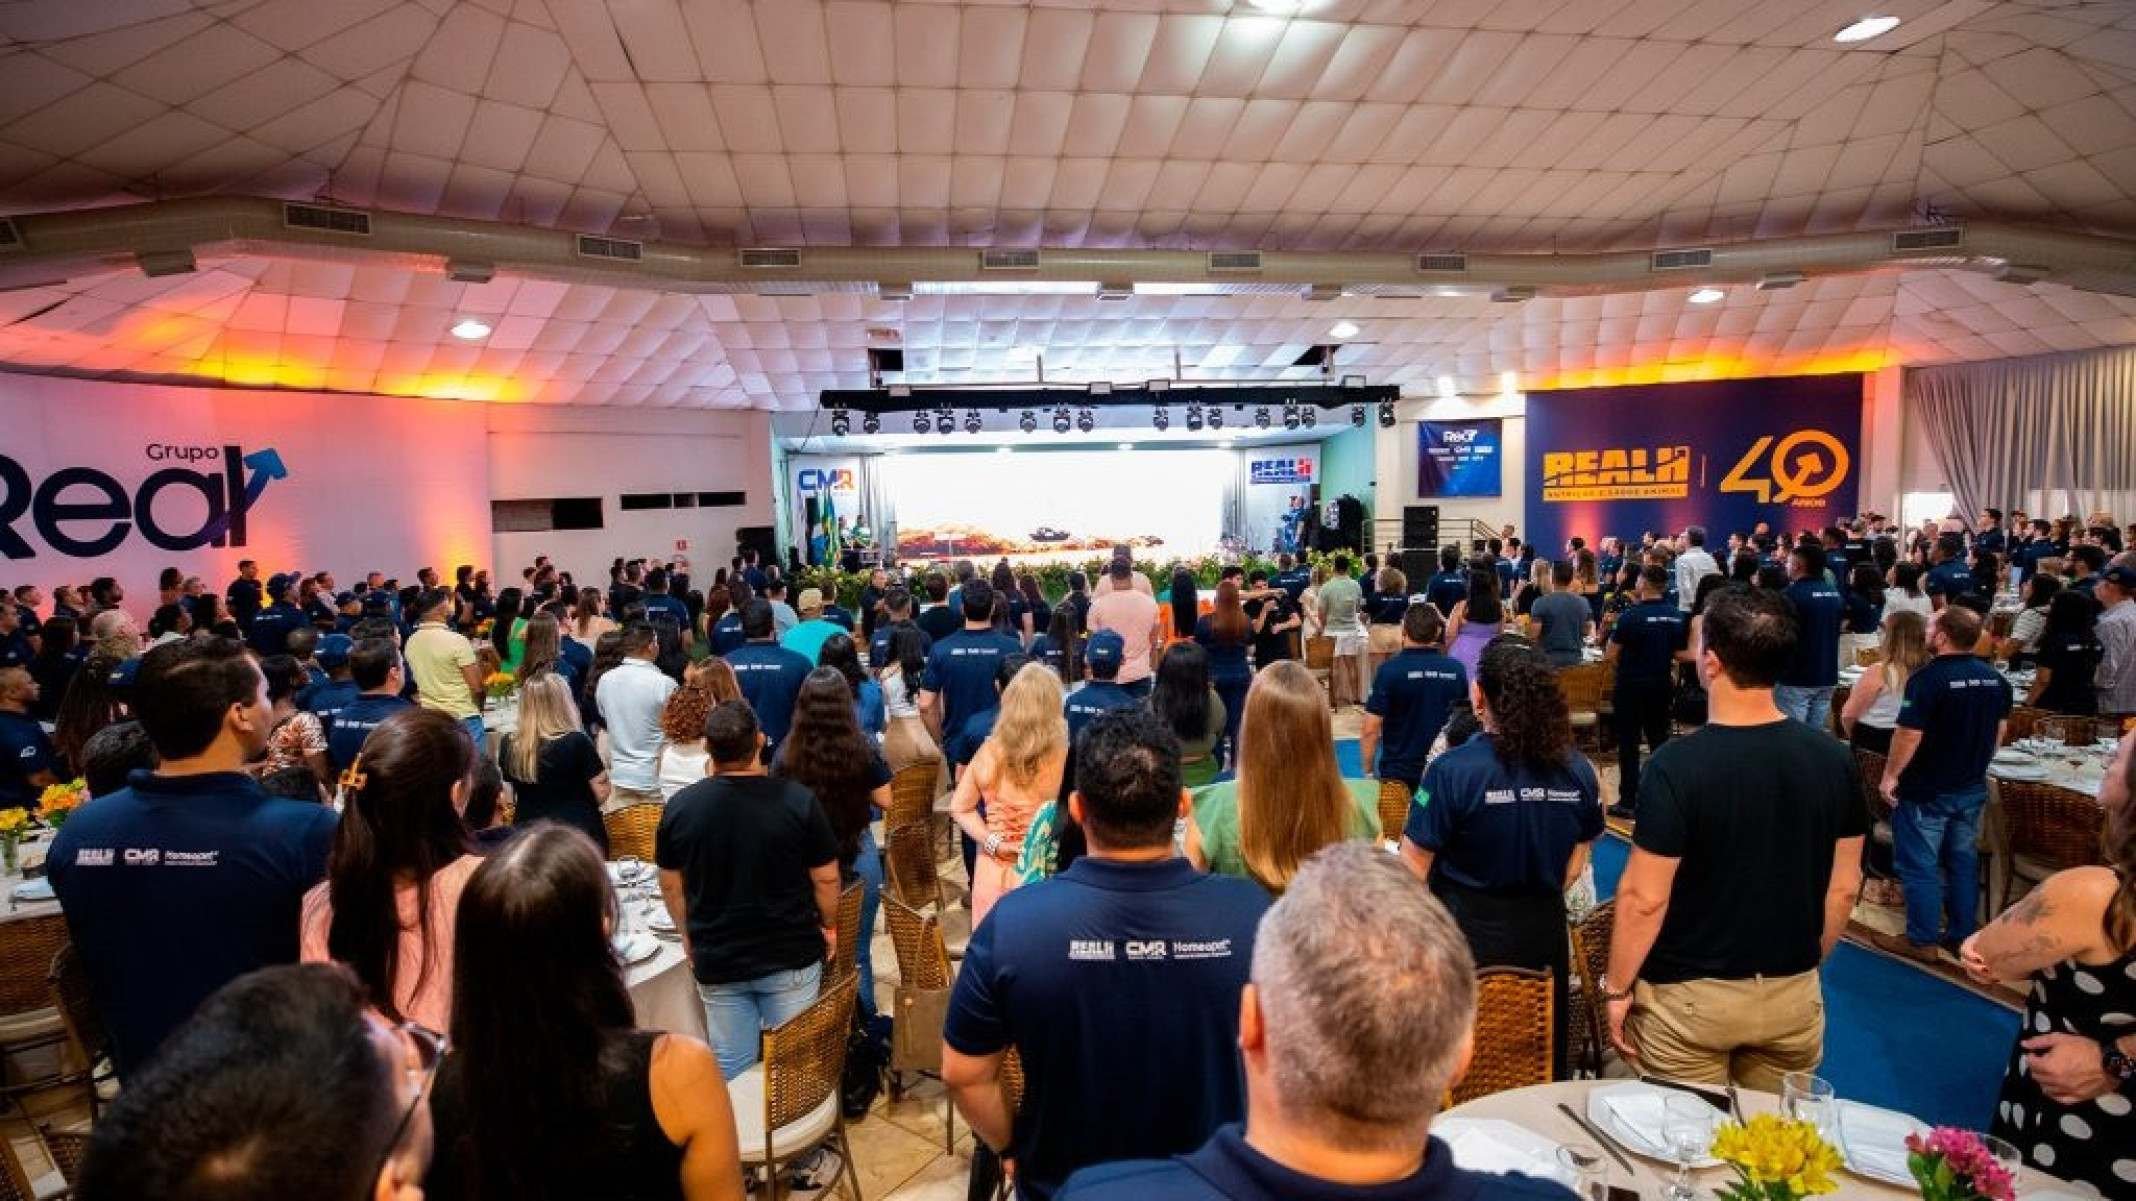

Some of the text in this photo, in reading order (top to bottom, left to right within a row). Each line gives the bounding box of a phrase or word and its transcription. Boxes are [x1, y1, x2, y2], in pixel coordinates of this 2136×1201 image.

[146, 443, 220, 462] Grupo
[798, 468, 855, 490] CMR
[1125, 940, 1166, 955] CMR
